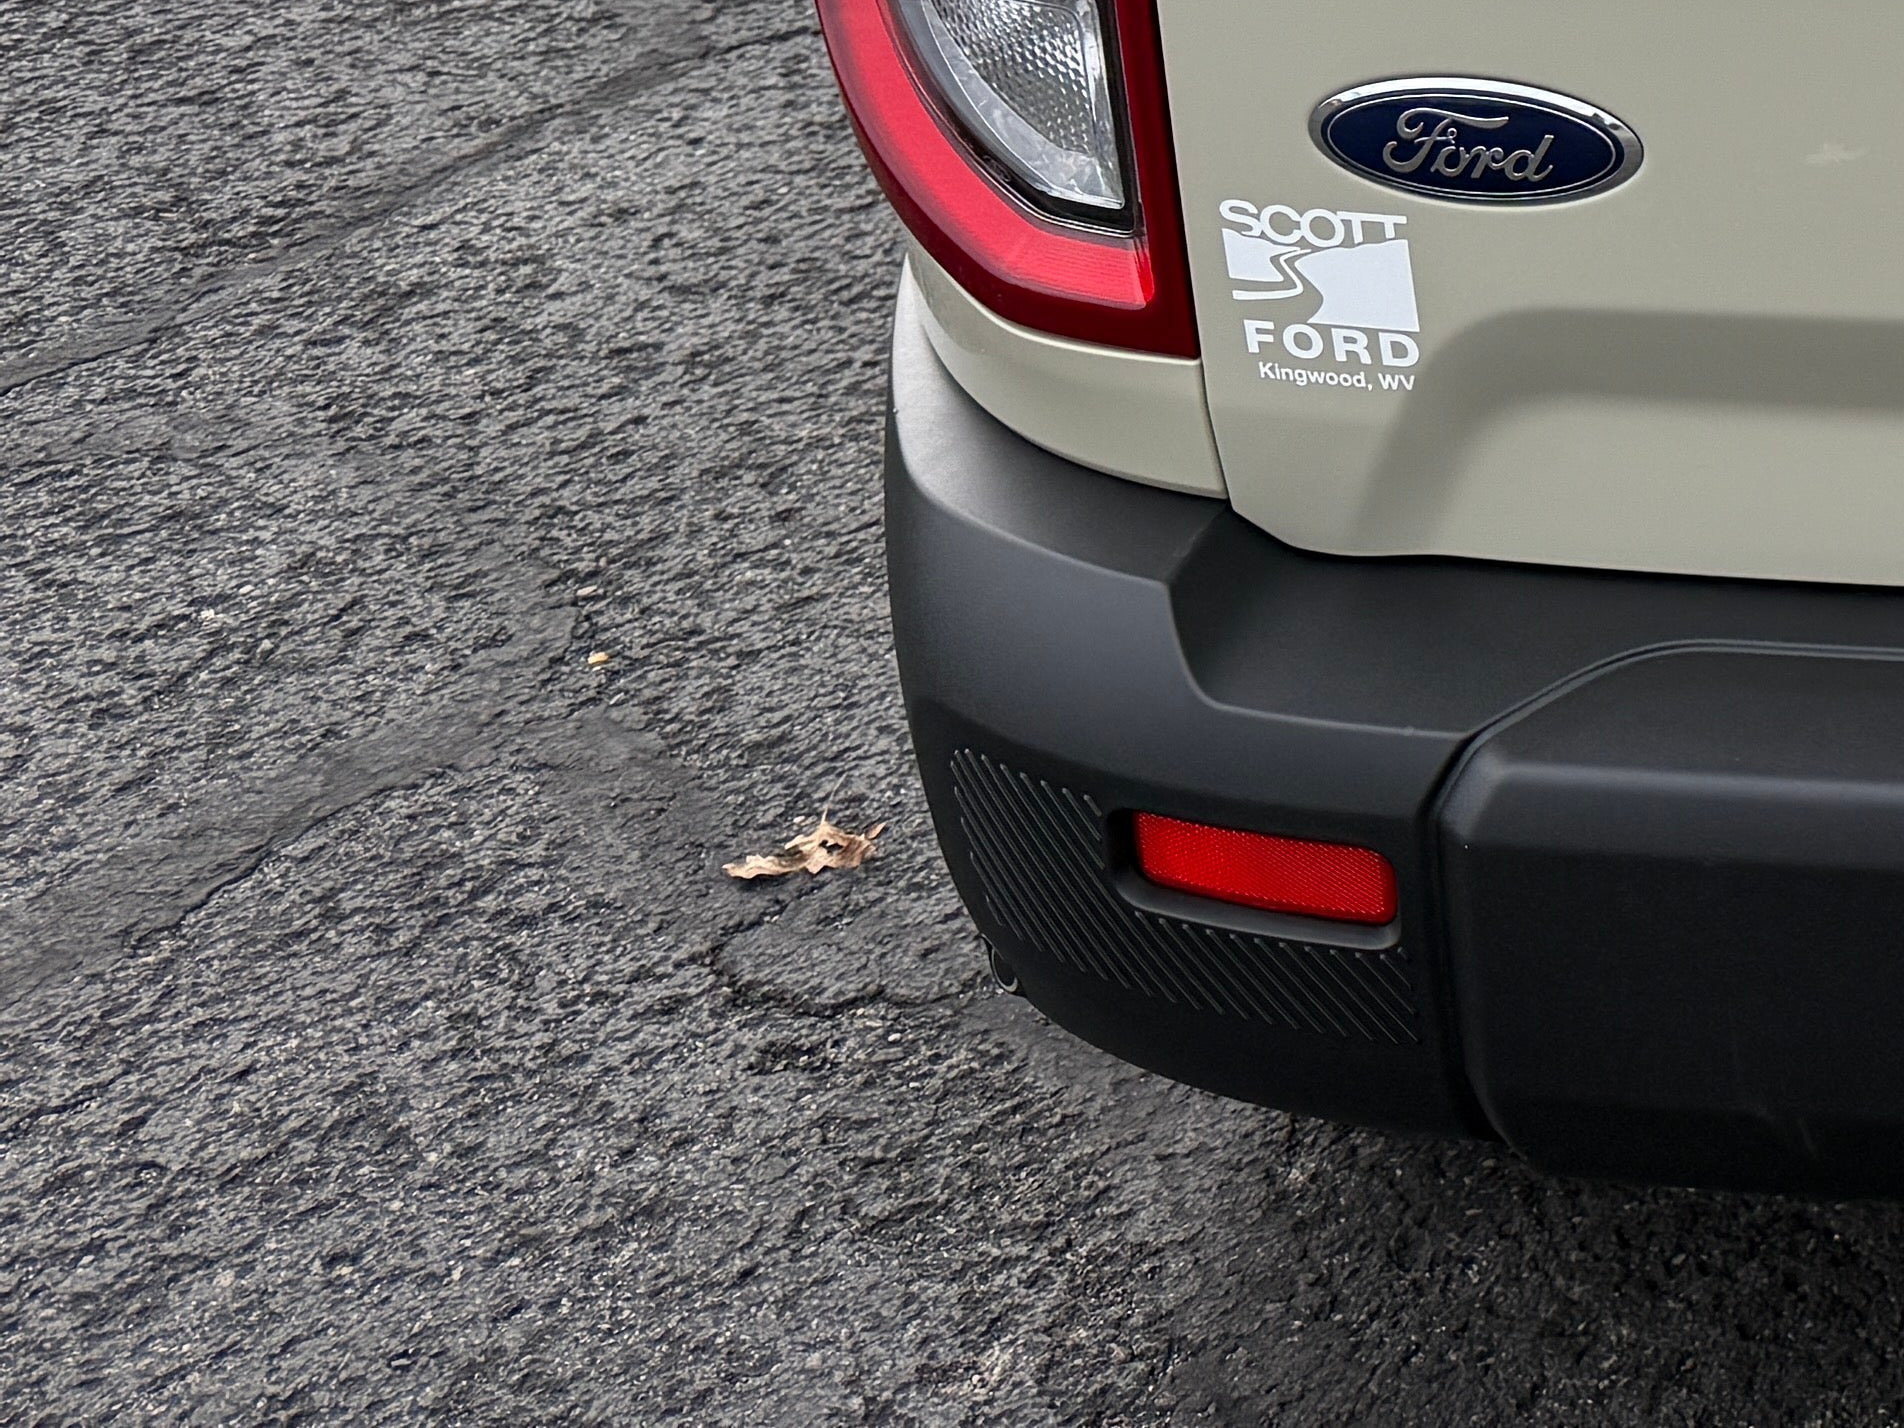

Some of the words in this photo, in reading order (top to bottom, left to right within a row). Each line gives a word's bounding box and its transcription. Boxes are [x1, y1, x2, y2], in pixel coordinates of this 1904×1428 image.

[1382, 106, 1556, 183] Ford
[1219, 199, 1408, 248] SCOTT
[1243, 319, 1420, 368] FORD
[1258, 361, 1373, 391] Kingwood,
[1378, 373, 1415, 391] WV
